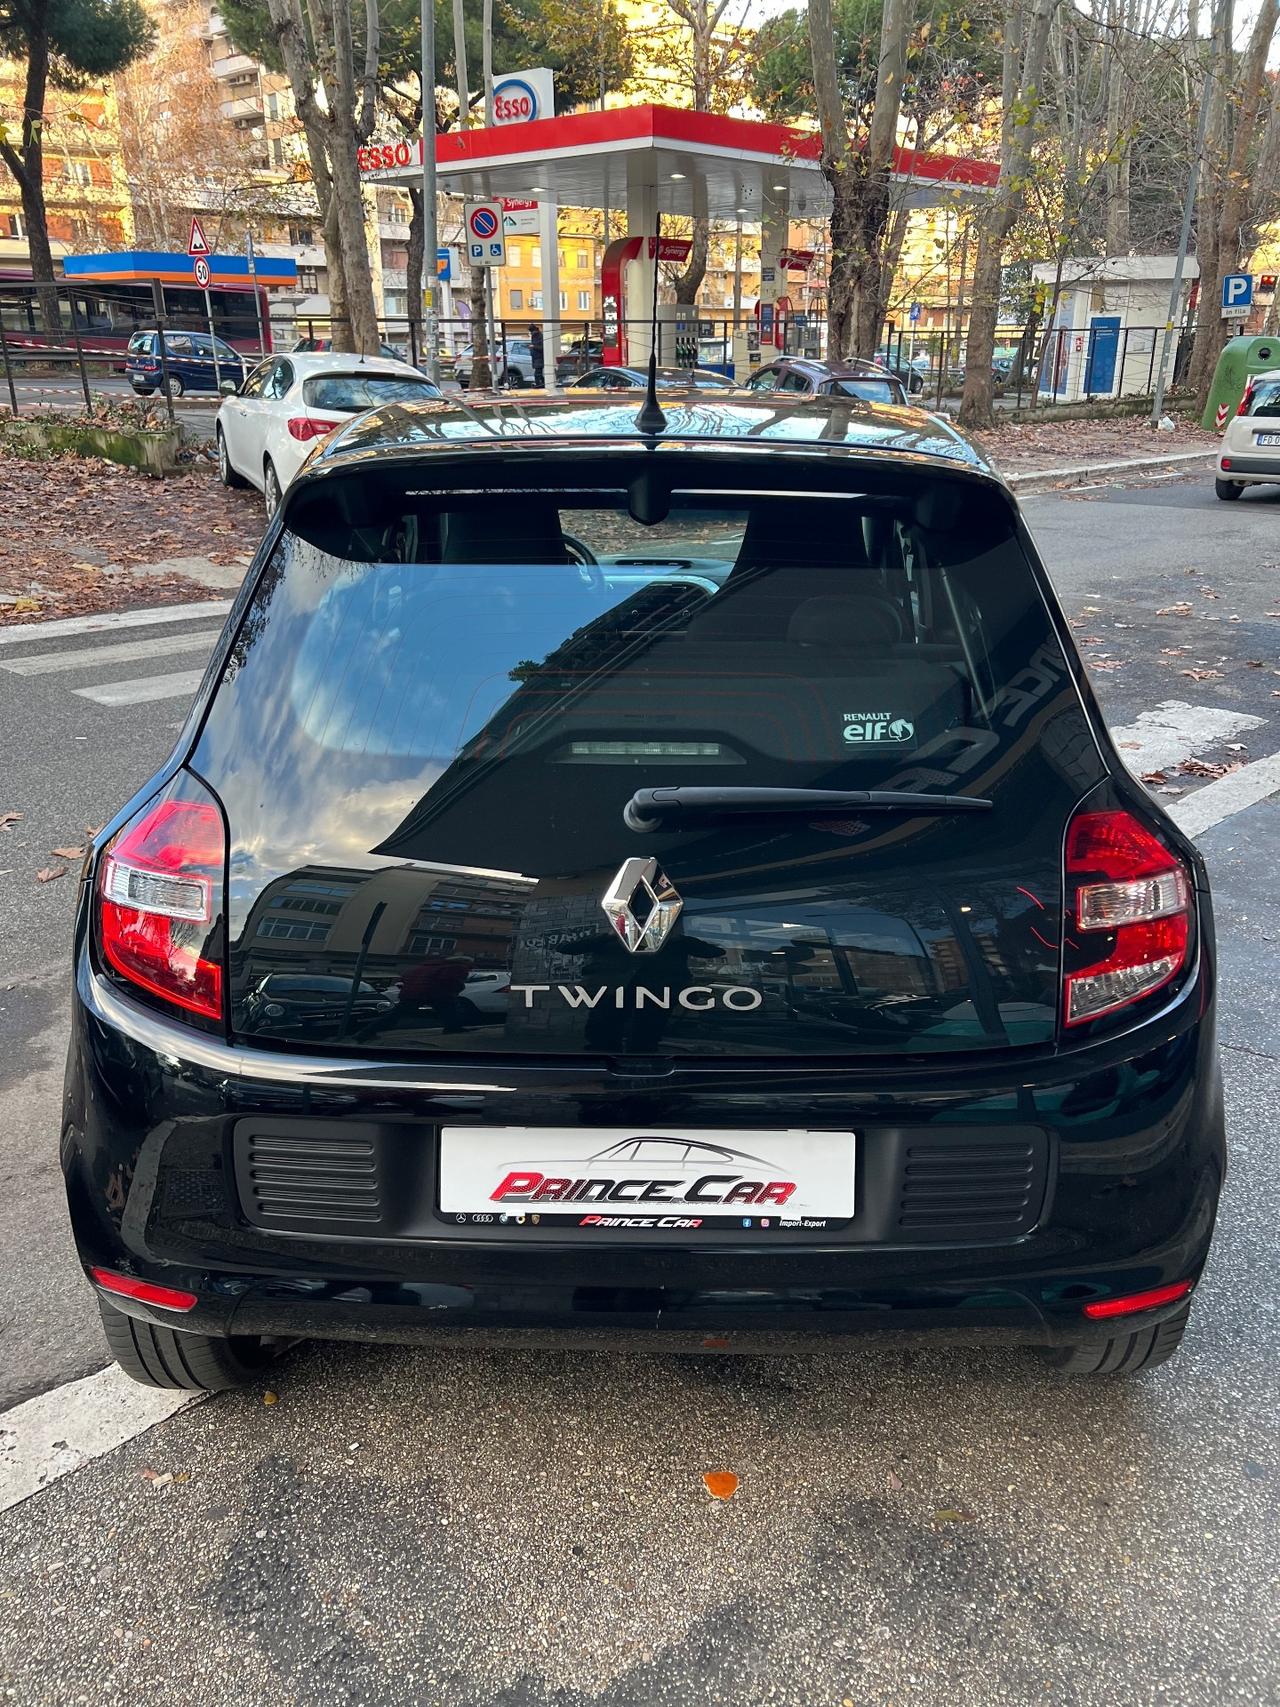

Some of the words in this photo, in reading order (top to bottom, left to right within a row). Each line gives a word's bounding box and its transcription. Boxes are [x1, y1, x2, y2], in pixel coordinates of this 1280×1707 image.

[474, 246, 481, 256] P
[197, 265, 207, 280] 50
[1228, 278, 1248, 304] P
[843, 712, 891, 721] RENAULT
[843, 723, 889, 741] elf
[510, 985, 762, 1011] TWINGO
